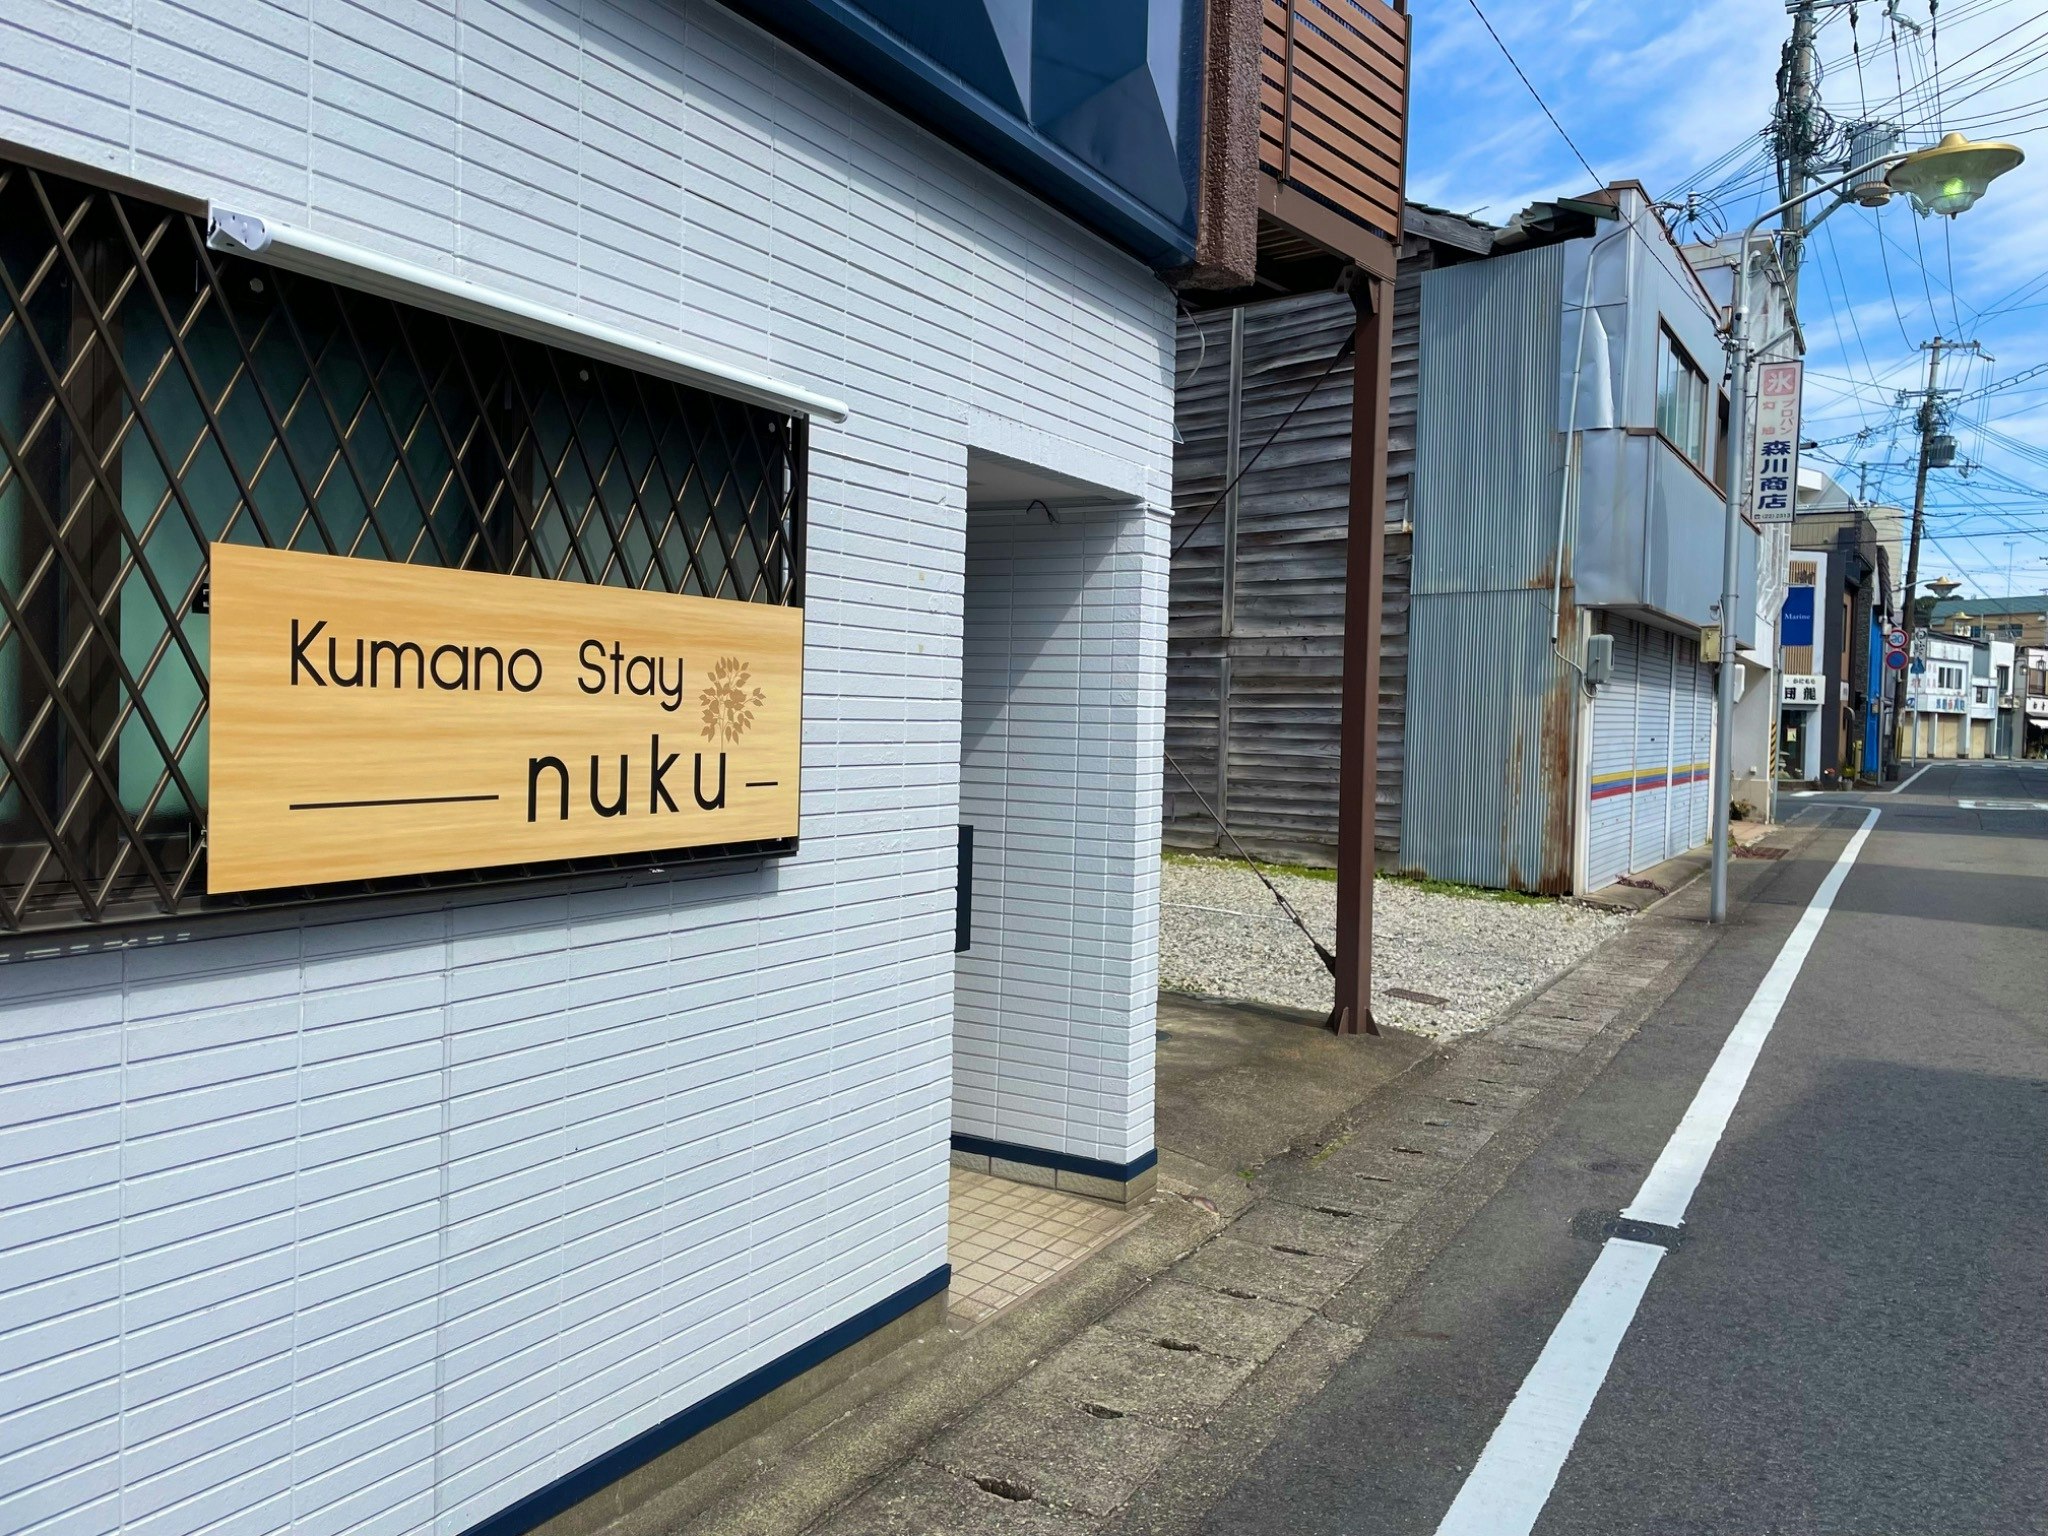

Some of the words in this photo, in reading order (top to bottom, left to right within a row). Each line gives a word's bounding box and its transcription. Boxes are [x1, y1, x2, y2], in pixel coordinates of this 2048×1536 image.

[1767, 370, 1793, 394] 氷
[1757, 440, 1791, 510] 森川商店
[290, 618, 543, 693] Kumano
[577, 639, 684, 712] Stay
[527, 734, 727, 823] nuku
